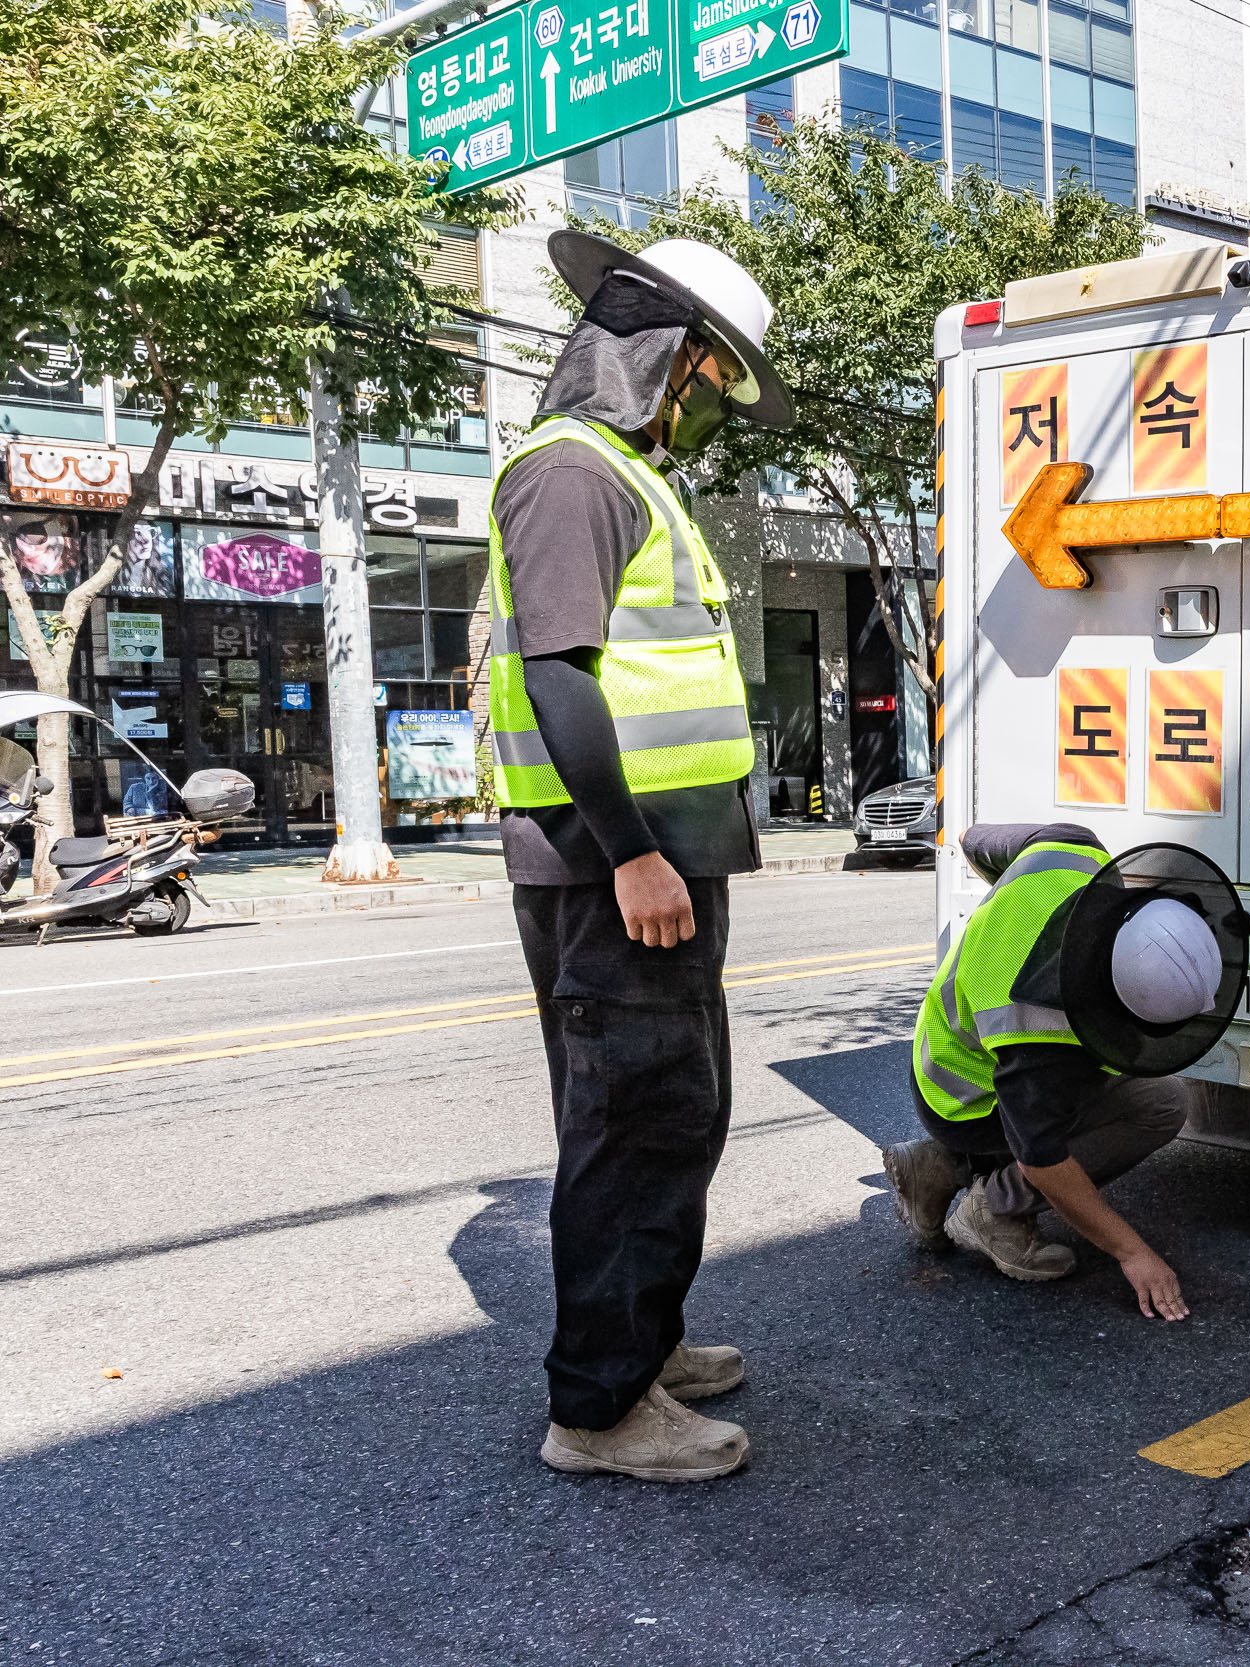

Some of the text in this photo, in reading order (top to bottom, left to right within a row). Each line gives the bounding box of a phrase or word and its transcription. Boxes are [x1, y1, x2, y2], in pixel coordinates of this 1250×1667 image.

[541, 14, 557, 39] 60
[569, 0, 650, 66] 건국대
[790, 9, 810, 41] 71
[704, 37, 747, 69] 뚝섬로
[417, 35, 511, 107] 영동대교
[569, 45, 663, 103] Konkuk University
[418, 79, 515, 141] Yeongdongdaegyo(Br)
[472, 131, 506, 161] 뚝섬로
[20, 489, 125, 505] SMILEOPTIC
[238, 547, 289, 573] SALE
[400, 713, 417, 723] 우리
